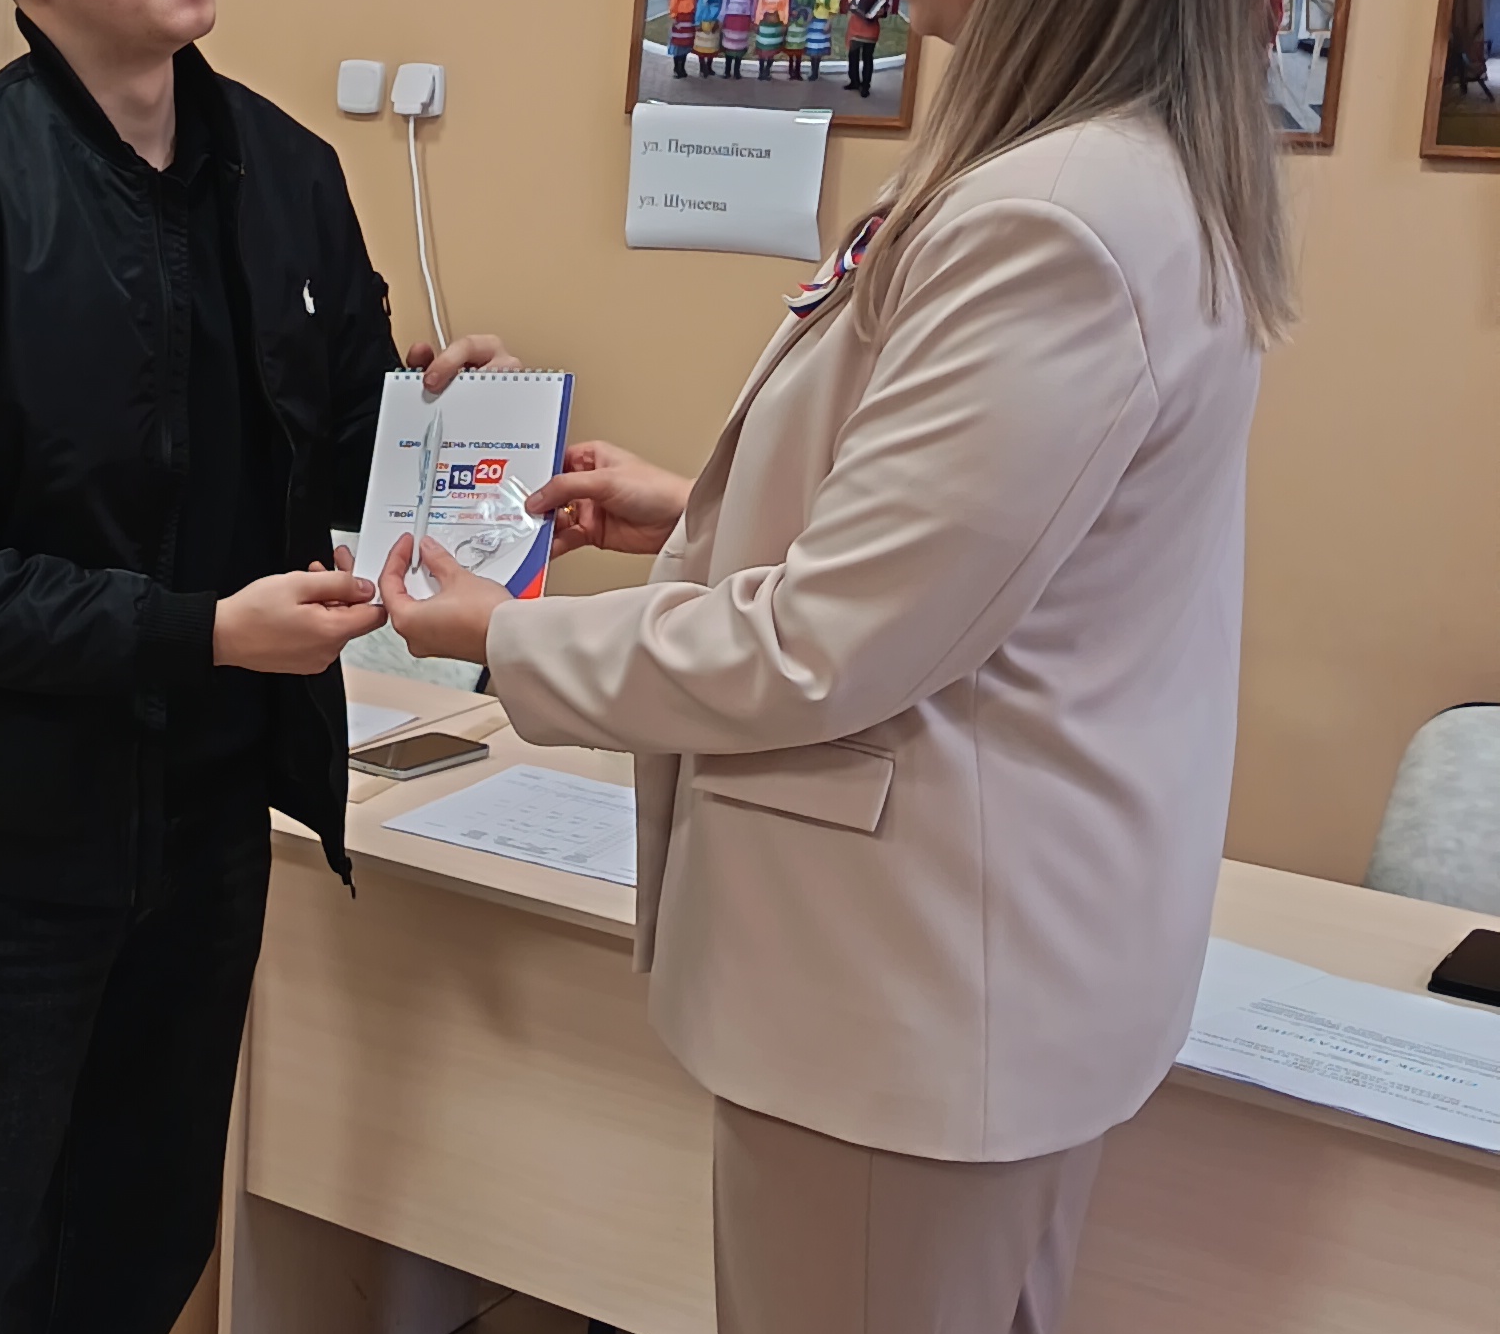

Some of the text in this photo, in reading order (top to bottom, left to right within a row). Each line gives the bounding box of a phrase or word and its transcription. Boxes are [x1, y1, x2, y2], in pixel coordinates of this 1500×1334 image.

[641, 138, 772, 160] ул. Первомайская
[638, 194, 659, 209] ул.
[452, 470, 472, 486] 19
[476, 463, 502, 480] 20
